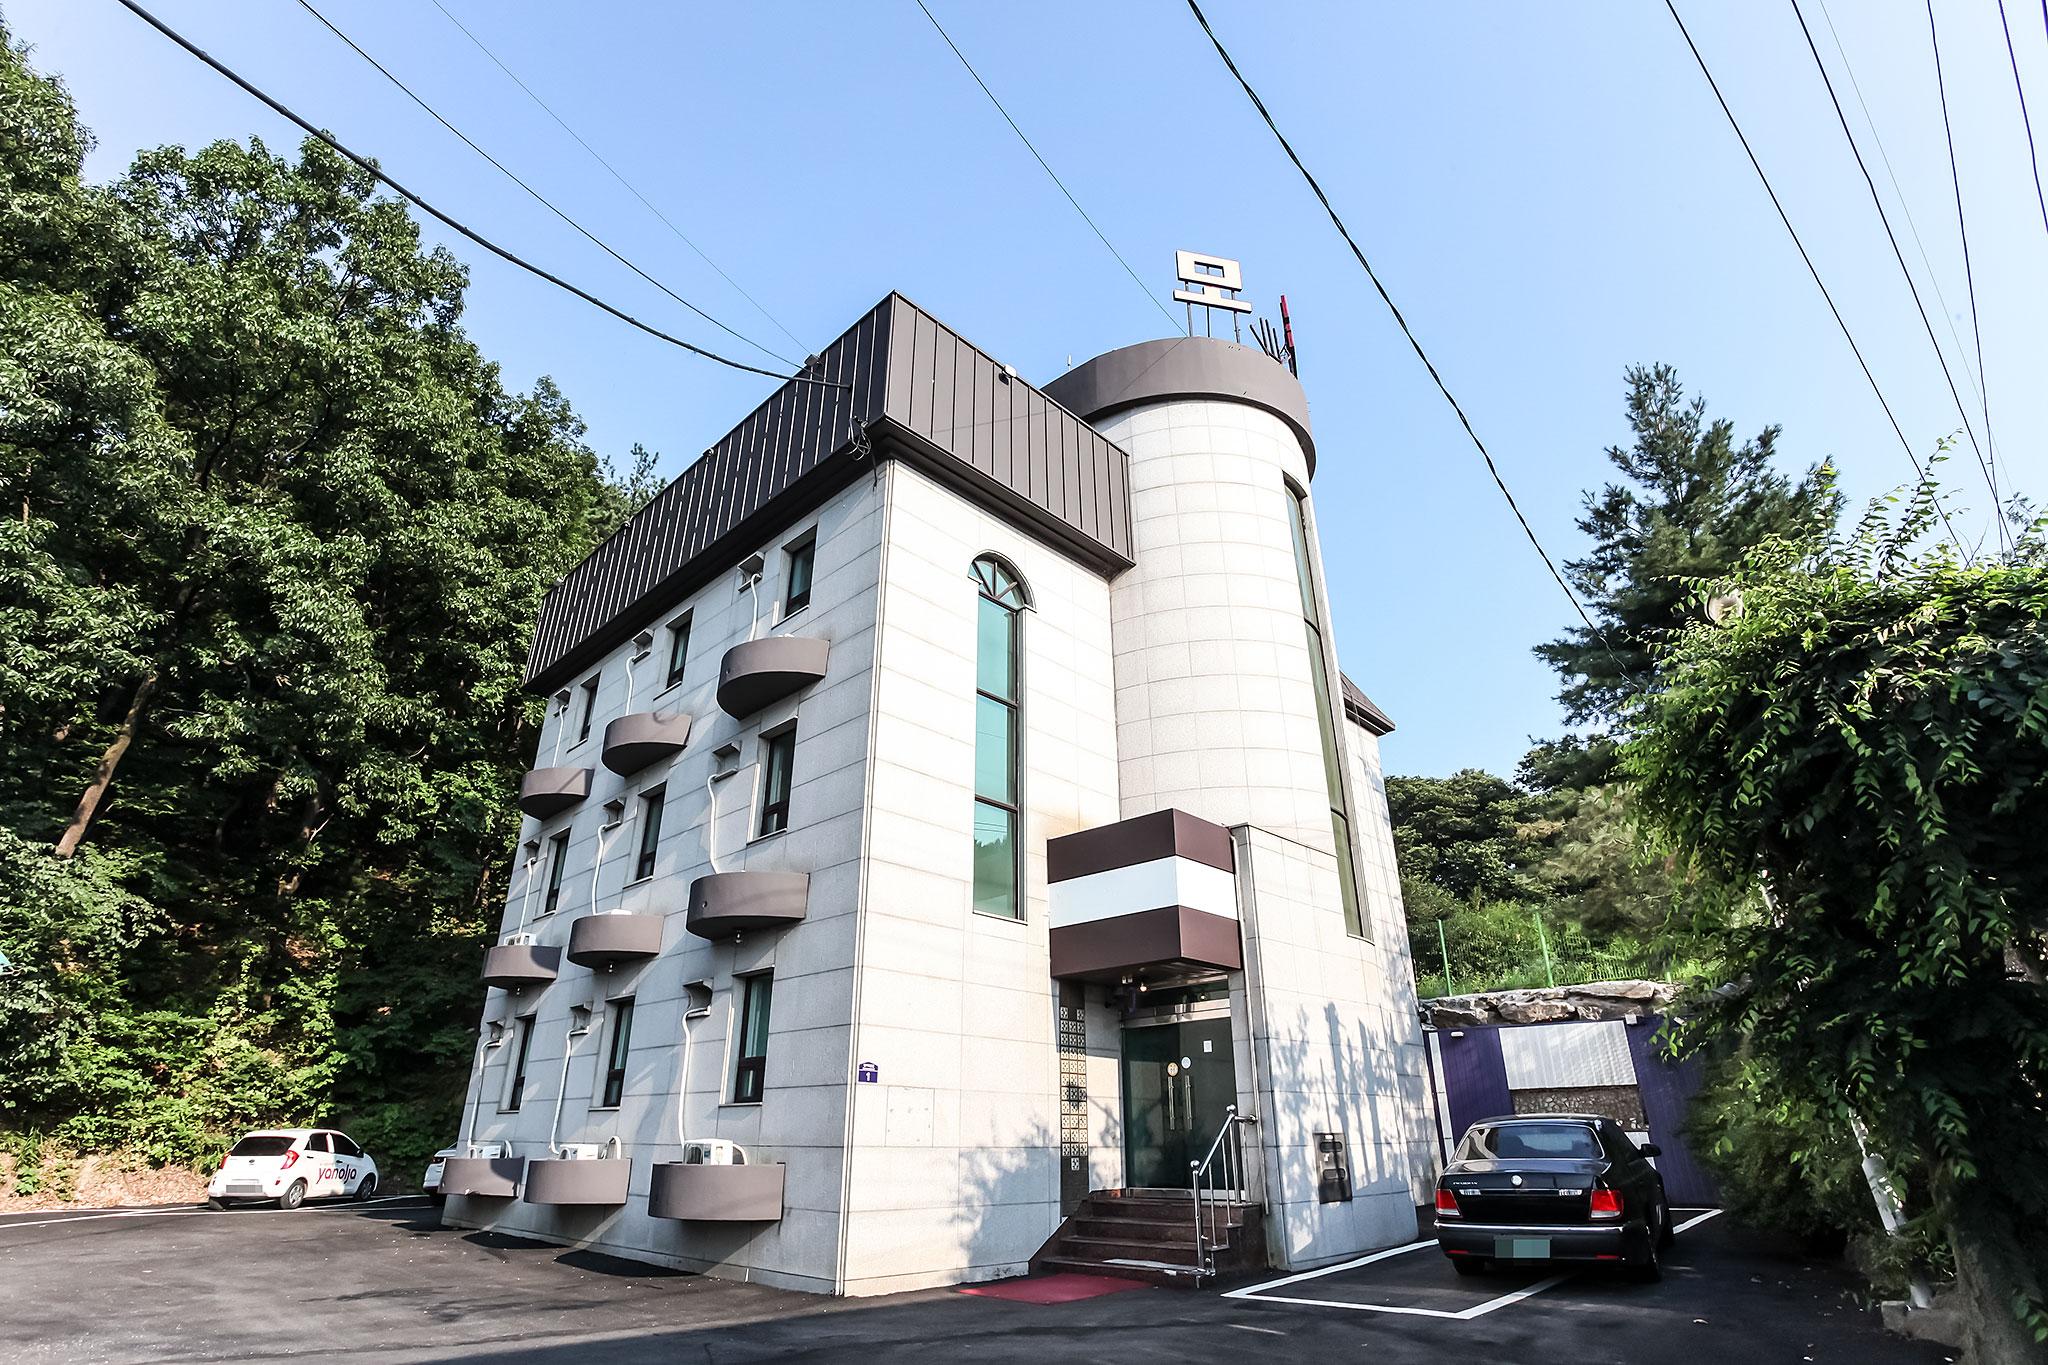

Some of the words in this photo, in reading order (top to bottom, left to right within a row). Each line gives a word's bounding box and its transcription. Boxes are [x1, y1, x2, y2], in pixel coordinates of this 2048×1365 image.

[1173, 250, 1252, 314] 모
[865, 1071, 871, 1082] 1
[315, 1164, 357, 1185] yanolja
